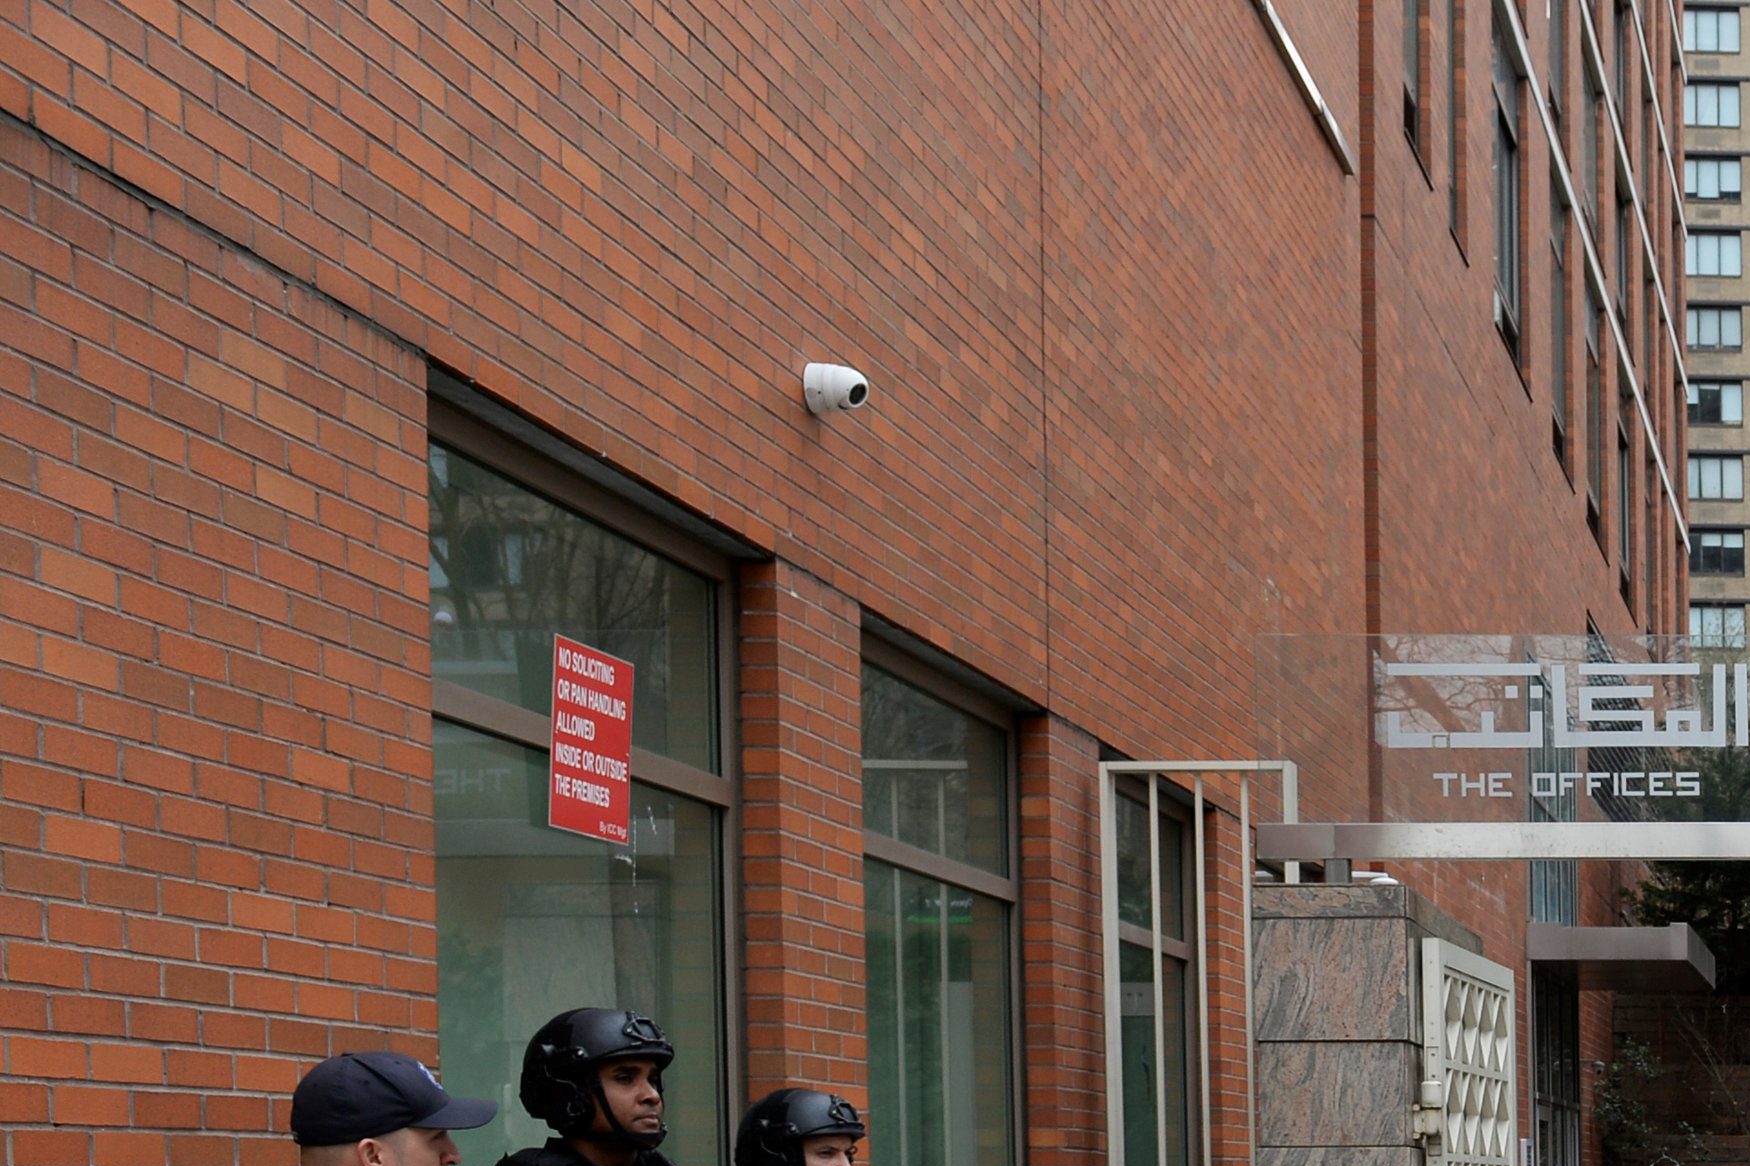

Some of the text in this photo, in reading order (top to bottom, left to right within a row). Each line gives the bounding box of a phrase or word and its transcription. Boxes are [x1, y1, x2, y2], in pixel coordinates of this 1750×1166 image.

[558, 647, 615, 686] NO SOLICITING
[557, 678, 627, 721] OR PAN HANDLING
[556, 710, 596, 741] ALLOWED
[555, 742, 627, 782] INSIDE OR OUTSIDE
[554, 773, 610, 808] THE PREMISES
[1434, 772, 1700, 797] THE OFFICES
